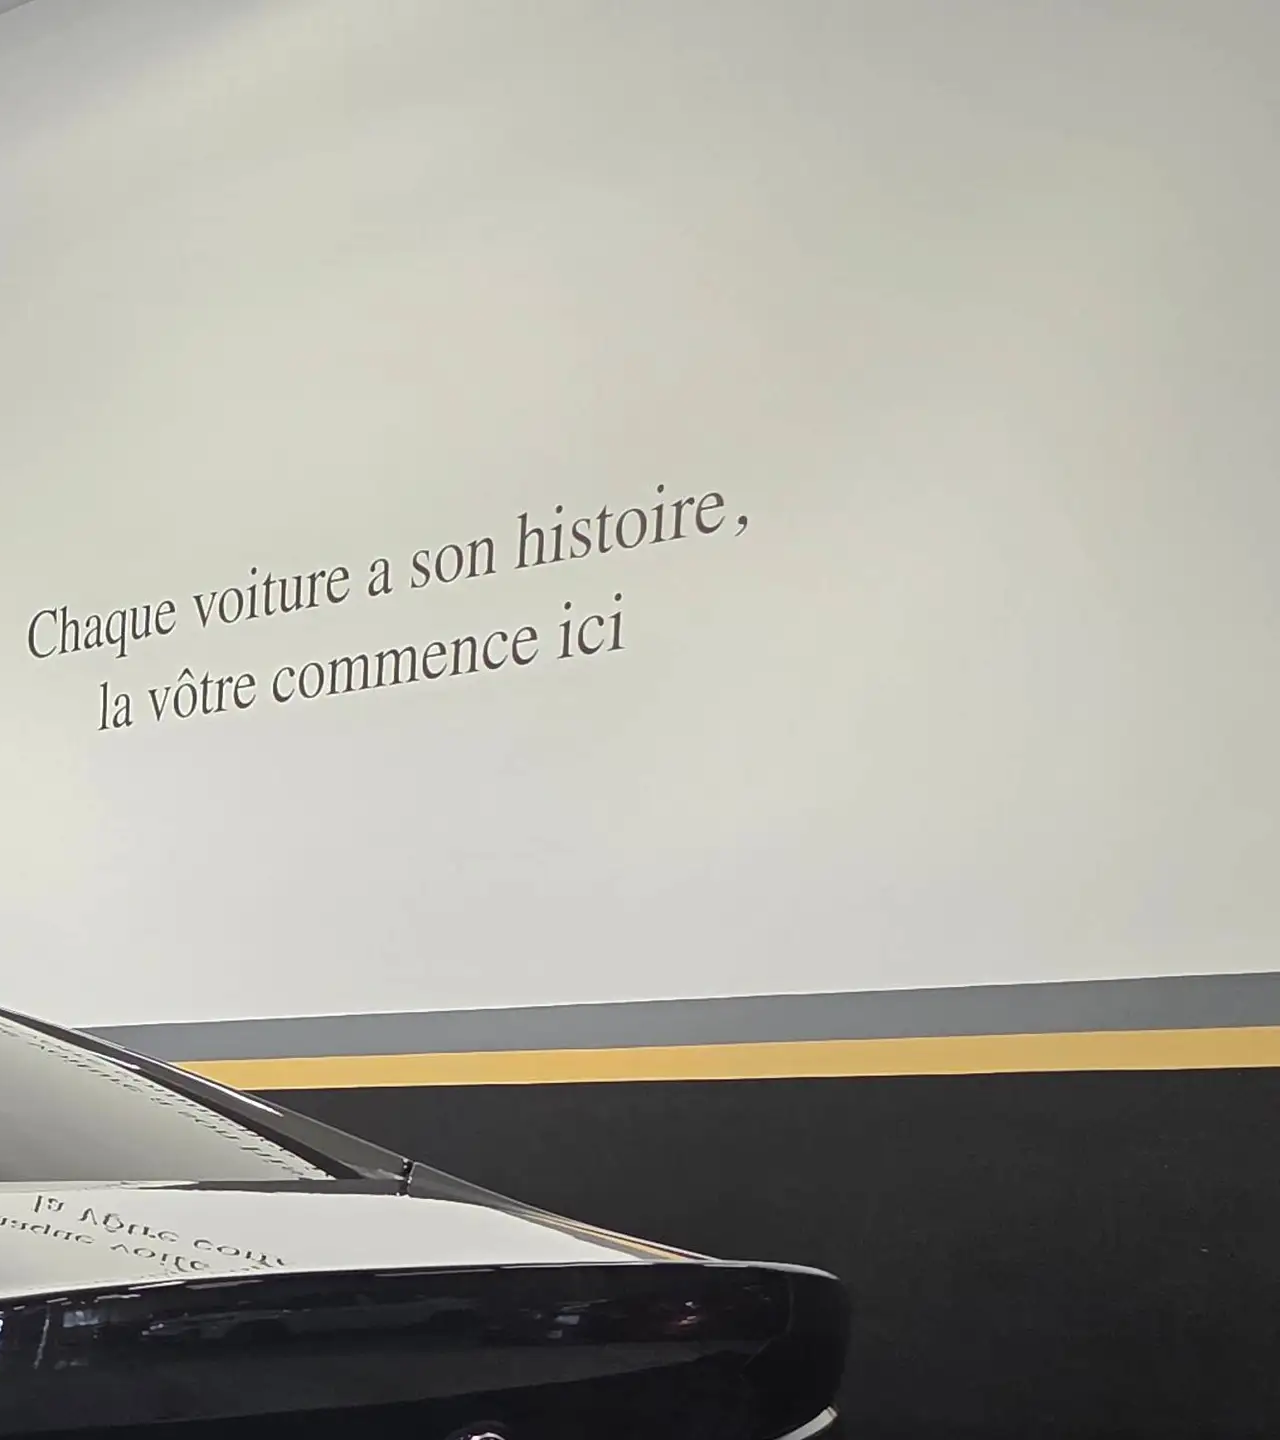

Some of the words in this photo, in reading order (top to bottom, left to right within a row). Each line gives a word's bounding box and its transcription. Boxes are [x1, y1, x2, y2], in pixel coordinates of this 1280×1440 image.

[28, 597, 177, 660] Chaque
[193, 566, 350, 628] voiture
[368, 558, 393, 597] a
[410, 536, 496, 588] son
[515, 484, 748, 569] histoire,
[98, 681, 133, 730] la
[149, 667, 255, 721] vôtre
[272, 624, 539, 702] commence
[557, 593, 624, 659] ici
